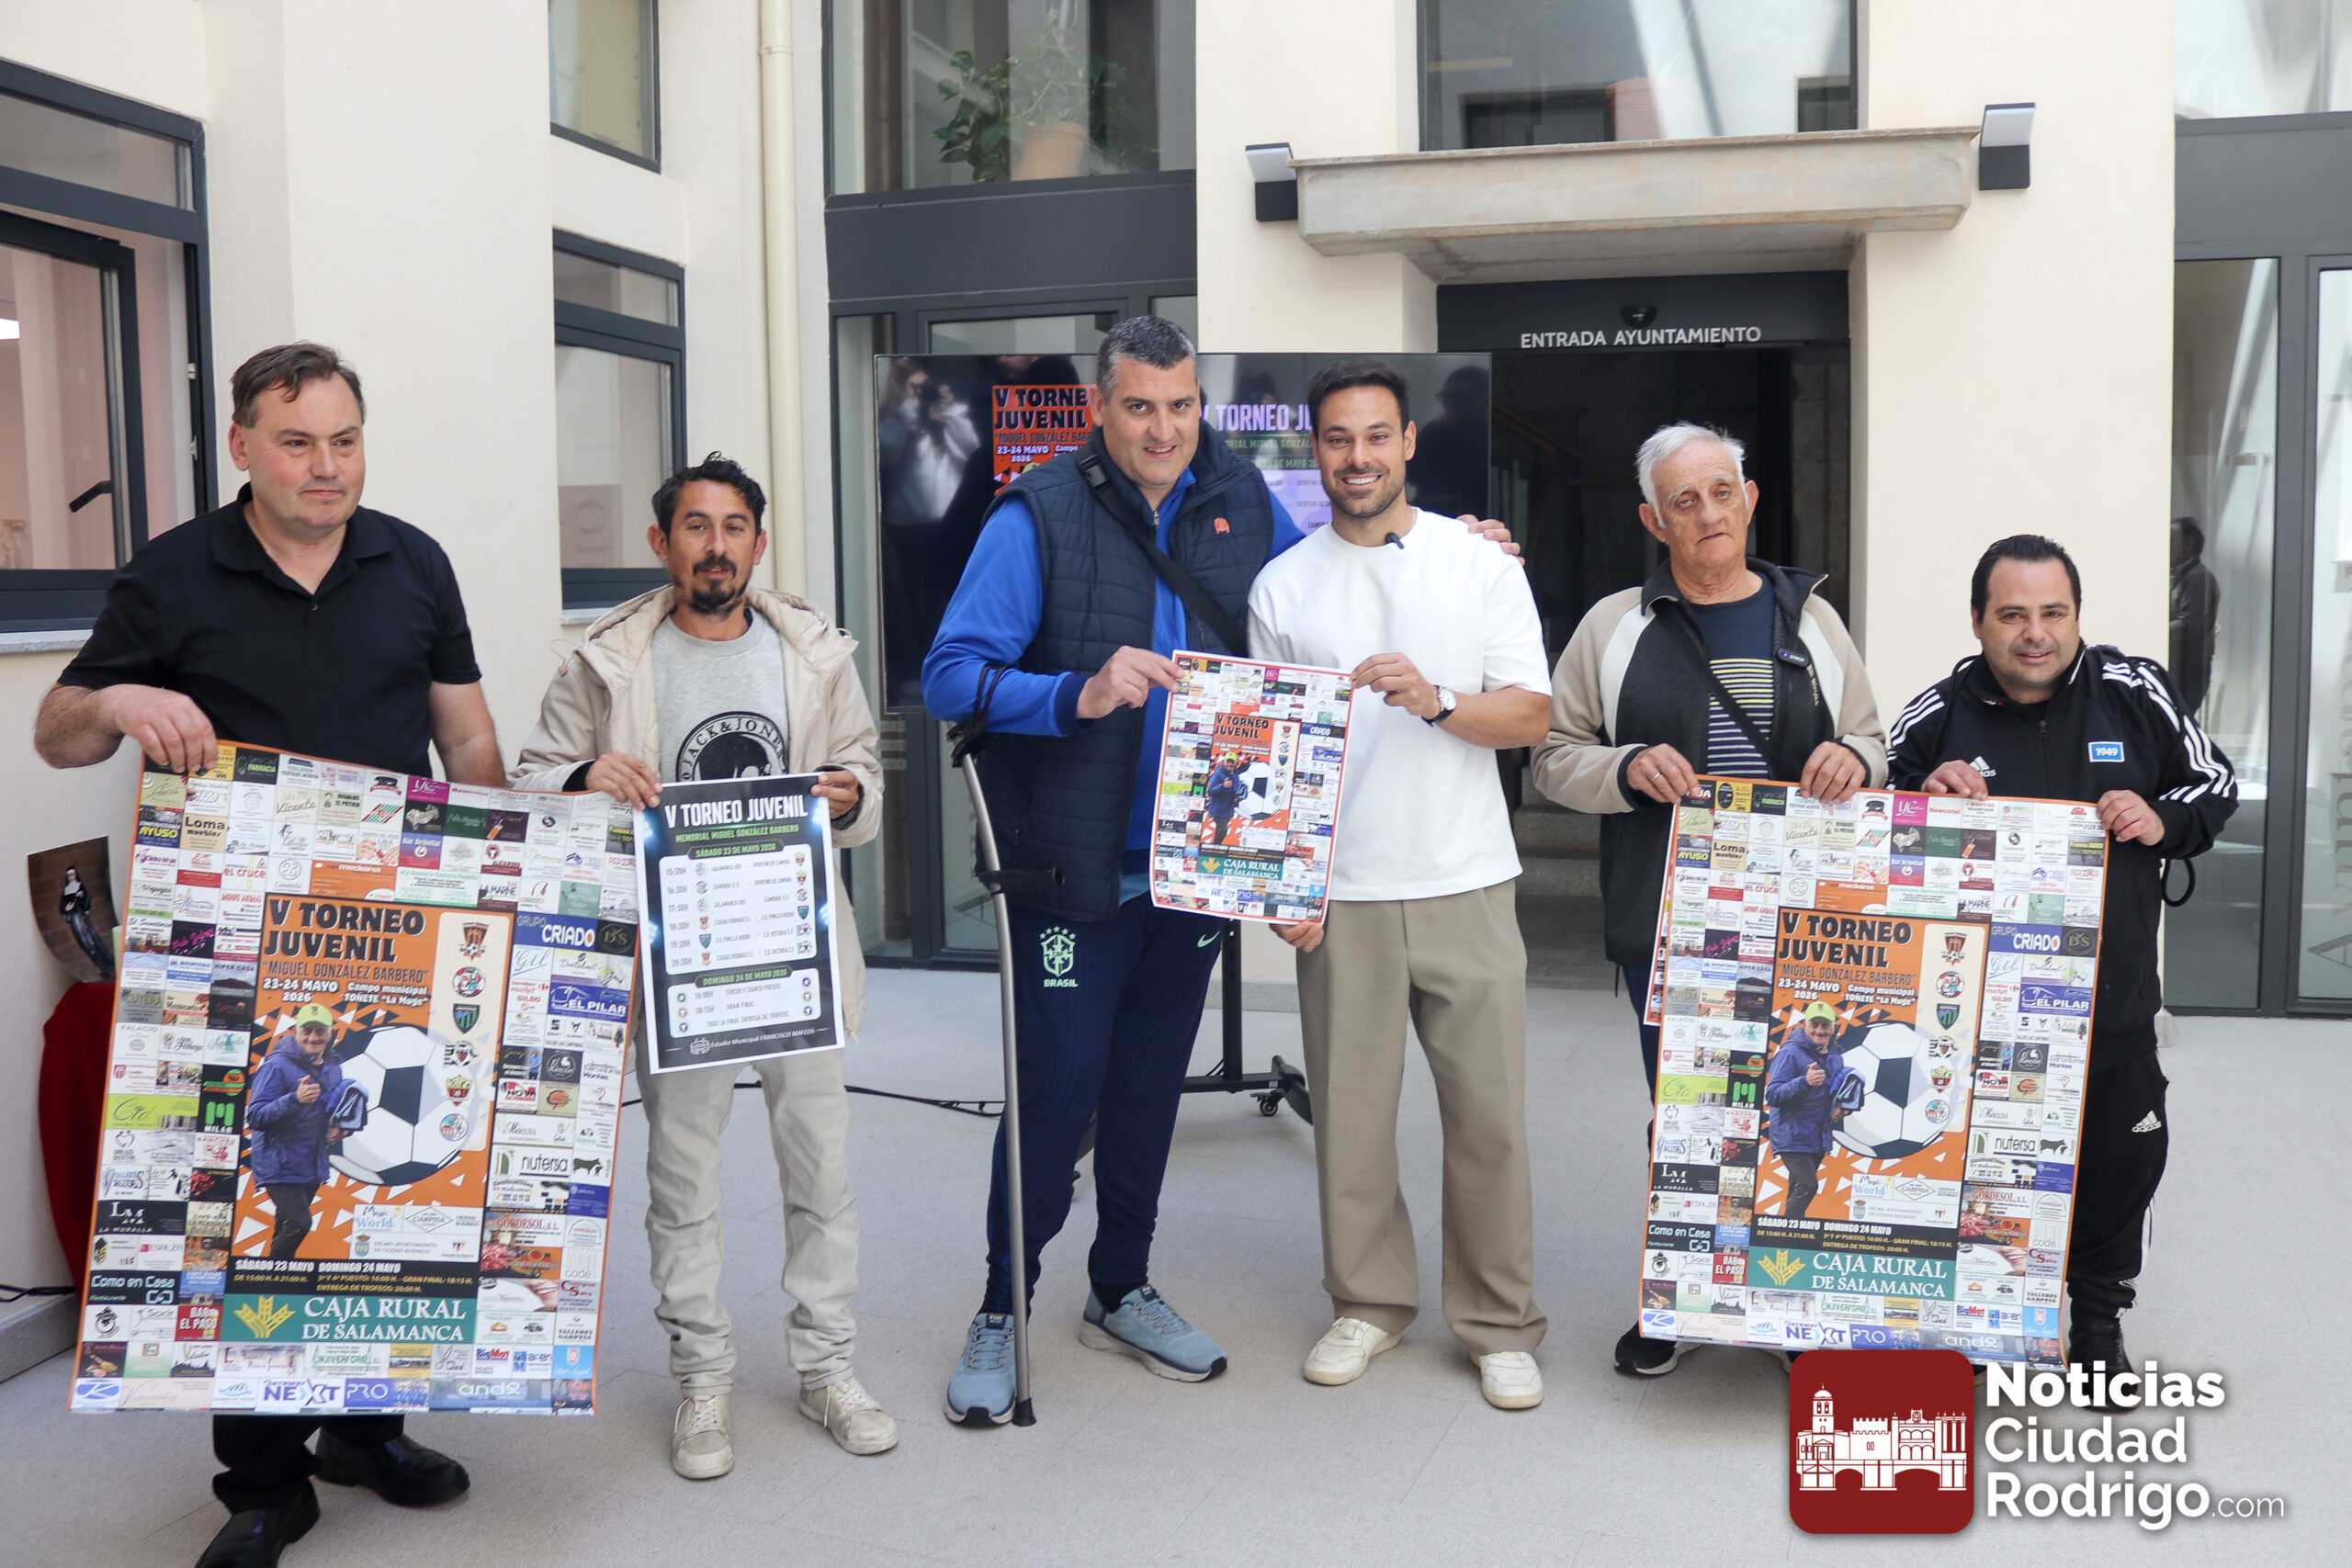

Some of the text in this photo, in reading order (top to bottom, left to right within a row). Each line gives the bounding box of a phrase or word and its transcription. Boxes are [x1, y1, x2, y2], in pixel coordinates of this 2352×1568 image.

[1521, 327, 1761, 348] ENTRADA AYUNTAMIENTO
[995, 388, 1088, 408] V TORNE
[995, 411, 1088, 430] JUVENIL
[1215, 404, 1289, 431] TORNEO
[1216, 714, 1269, 728] V TORNEO
[1215, 724, 1261, 739] JUVENIL
[664, 795, 808, 829] V TORNEO JUVENIL
[185, 817, 224, 829] Loma
[140, 827, 177, 838] AYUSO
[675, 831, 710, 843] MEMORIAL
[1713, 842, 1746, 852] Loma
[1678, 852, 1708, 860] AYUSO
[236, 867, 265, 878] cruce
[1249, 860, 1279, 873] RURAL
[1755, 884, 1779, 894] cruce
[269, 900, 426, 936] V TORNEO
[517, 915, 545, 927] GRUPO
[542, 924, 595, 946] CRIADO
[1782, 912, 1912, 945] V TORNEO
[1992, 926, 2017, 937] GRUPO
[265, 931, 397, 964] JUVENIL
[2013, 933, 2061, 952] CRIADO
[1779, 939, 1889, 968] JUVENIL
[263, 977, 338, 992] 23-24 MAYO
[347, 982, 426, 995] Campo municipal
[1044, 978, 1079, 987] BRASIL
[1779, 978, 1840, 992] 23-24 MAYO
[1793, 990, 1818, 1000] 2026
[1848, 985, 1915, 997] Campo municipal
[568, 1000, 626, 1015] EL PILAR
[2037, 998, 2089, 1010] EL PILAR
[1995, 1137, 2036, 1152] nutersa
[1648, 1224, 1712, 1238] Como en Casa
[1758, 1217, 1820, 1231] SÁBADO 23 MAYO
[1824, 1222, 1892, 1235] DOMINGO 24 MAYO
[234, 1259, 314, 1272] SÁBADO 23 MAYO
[319, 1262, 401, 1273] DOMINGO 24 MAYO
[1813, 1252, 1947, 1279] CAJA RURAL
[92, 1276, 175, 1288] Como en Casa
[1812, 1275, 1946, 1297] DE SALAMANCA
[304, 1297, 467, 1323] CAJA RURAL
[302, 1324, 463, 1341] DE SALAMANCA
[1851, 1328, 1886, 1343] PRO
[346, 1382, 389, 1400] PRO
